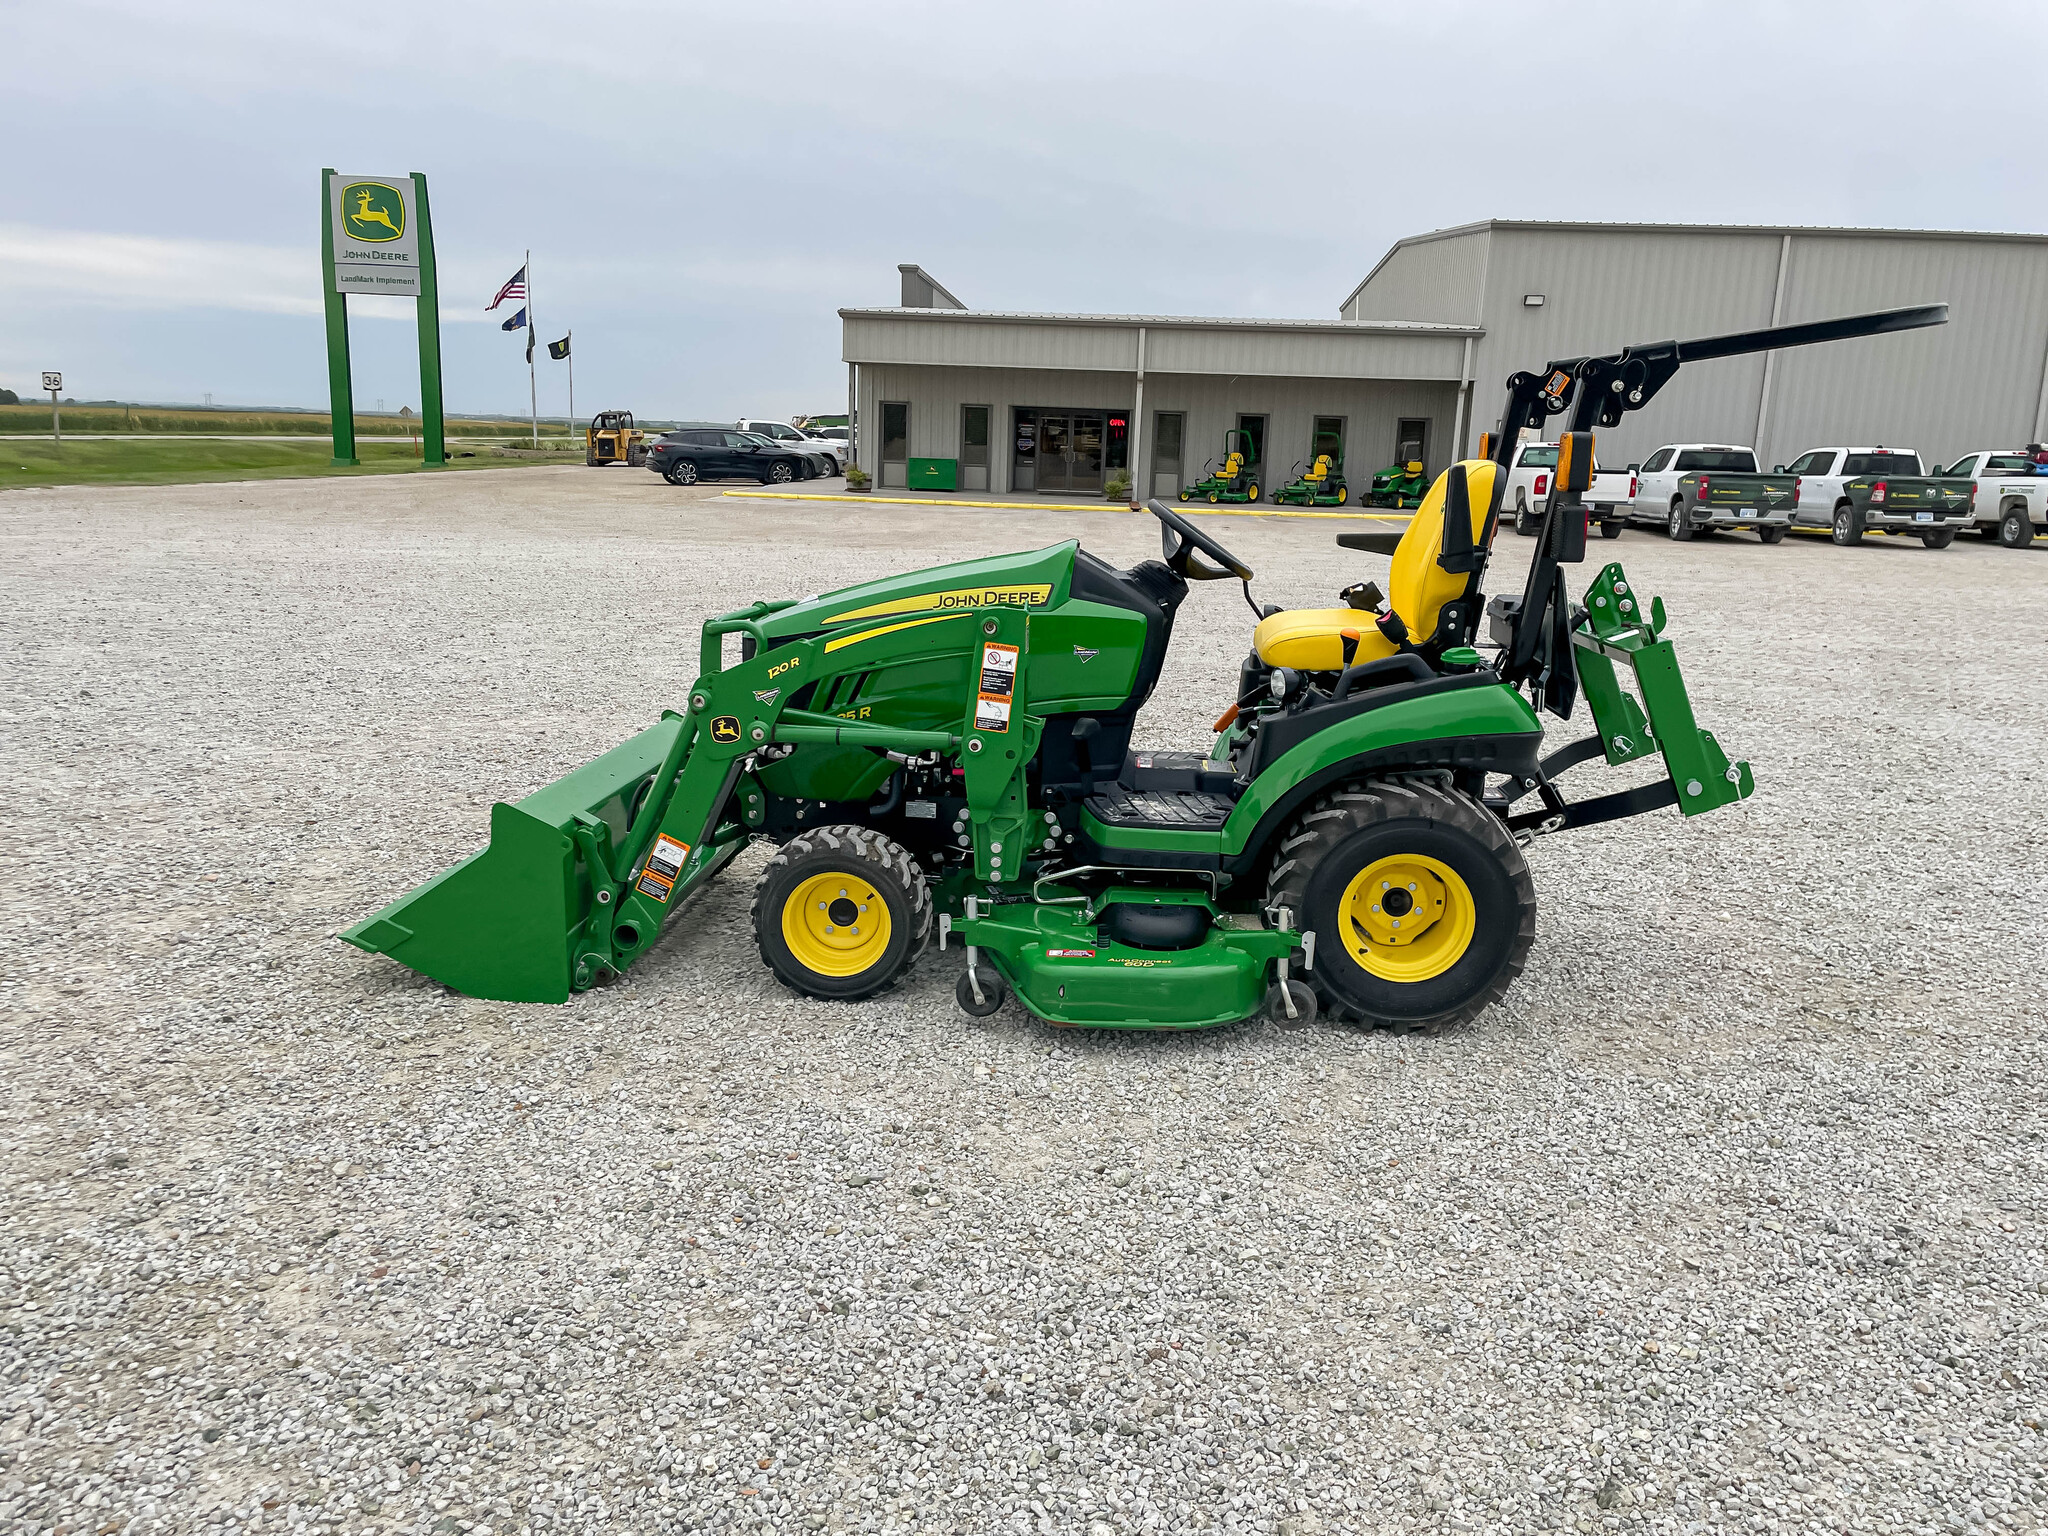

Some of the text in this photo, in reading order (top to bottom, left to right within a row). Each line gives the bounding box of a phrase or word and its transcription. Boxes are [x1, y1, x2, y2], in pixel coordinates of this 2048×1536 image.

[342, 249, 409, 261] JOHN DEERE
[340, 275, 415, 286] LandMark Implement
[44, 376, 60, 386] 36
[1109, 418, 1125, 427] OPEN
[932, 591, 1040, 608] JOHN DEERE
[991, 644, 1017, 652] WARNING
[767, 656, 800, 680] 120 R
[984, 695, 1011, 704] WARNING
[859, 706, 872, 719] R
